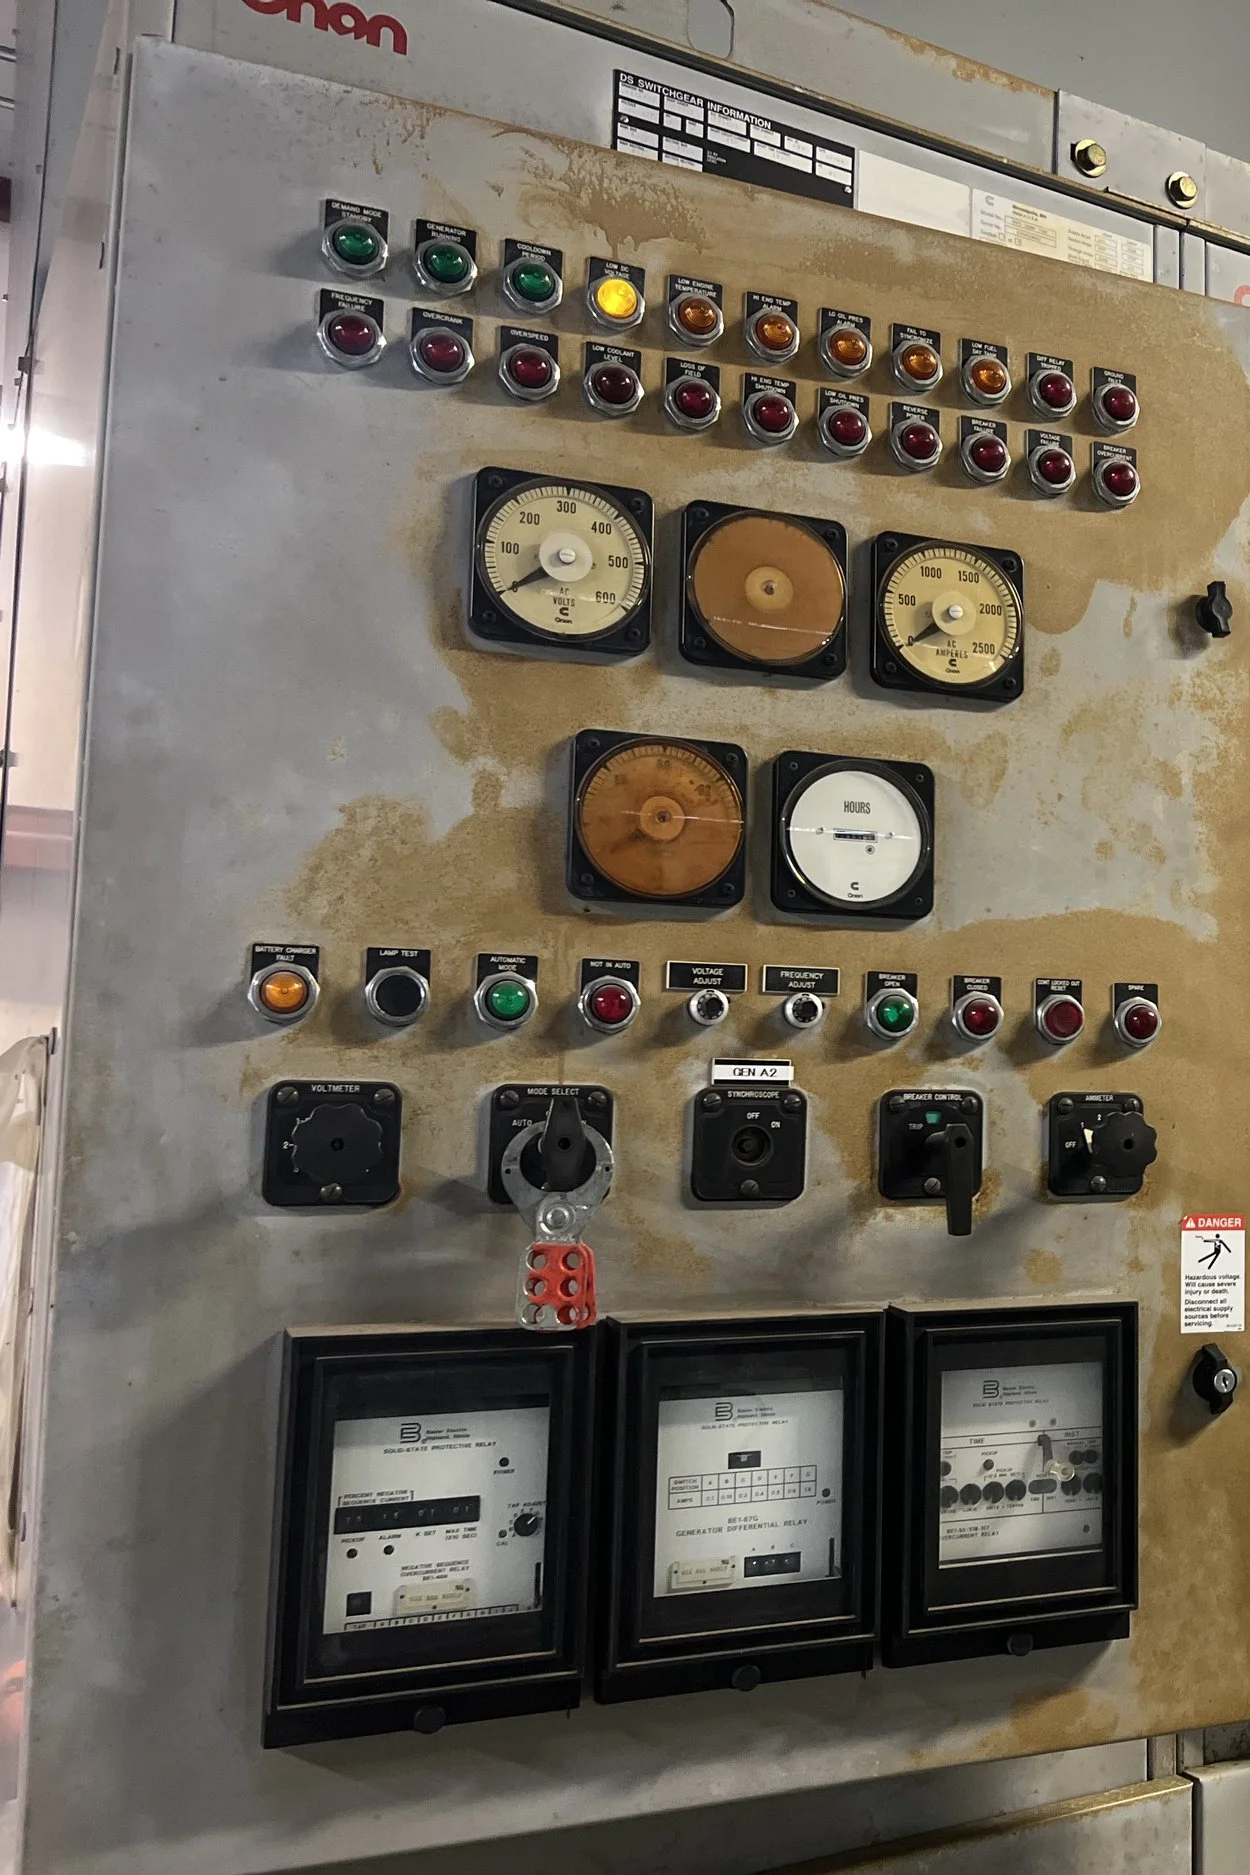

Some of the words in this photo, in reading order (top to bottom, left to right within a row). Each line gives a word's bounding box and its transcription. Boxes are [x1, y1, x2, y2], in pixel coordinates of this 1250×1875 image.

[620, 73, 633, 84] DS
[638, 79, 704, 107] SWITCHGEAR
[708, 102, 771, 129] INFORMATION
[332, 202, 360, 214] DEMAND
[363, 208, 382, 218] MODE
[427, 223, 466, 236] GENERATOR
[517, 244, 551, 256] COOLDOWN
[522, 252, 545, 262] PERIOD
[606, 262, 619, 270] LOW
[605, 268, 630, 280] VOLTAGE
[678, 278, 691, 286] LOW
[693, 280, 714, 290] ENGINE
[675, 284, 717, 298] TEMPERATURE
[331, 293, 372, 306] FREQUENCY
[423, 311, 463, 324] OVERCRANK
[511, 330, 549, 341] OVERSPEED
[593, 345, 605, 353] LOW
[607, 347, 635, 358] COOLANT
[604, 354, 622, 363] LEVEL
[680, 362, 696, 370] LOSS
[685, 370, 701, 378] FIELD
[557, 501, 577, 514] 300
[519, 512, 540, 525] 200
[591, 521, 612, 535] 400
[501, 542, 519, 554] 100
[608, 555, 628, 568] 500
[920, 566, 942, 579] 1000
[958, 570, 980, 584] 1500
[553, 597, 575, 607] VOLTS
[596, 592, 616, 604] 600
[898, 594, 916, 606] 500
[979, 603, 1002, 616] 2000
[947, 640, 956, 649] AC
[972, 642, 995, 655] 2500
[935, 648, 968, 659] AMPERES
[844, 800, 871, 814] HOURS
[255, 945, 284, 953] BATTERY
[286, 947, 317, 955] CHARGER
[490, 956, 526, 964] AUTOMATIC
[615, 962, 631, 970] AUTO
[692, 967, 724, 976] VOLTAGE
[780, 971, 824, 980] FREQUENCY
[964, 977, 990, 985] BREAKER
[693, 977, 722, 986] ADJUST
[788, 980, 816, 989] ADJUST
[733, 1068, 755, 1077] GEN
[760, 1068, 777, 1077] A2
[311, 1085, 360, 1093] VOLTMETER
[551, 1088, 580, 1096] SELECT
[728, 1090, 780, 1099] SYNCHROSCOPE
[903, 1093, 933, 1101] BREAKER
[934, 1094, 962, 1102] CONTROL
[747, 1112, 760, 1120] OFF
[512, 1119, 532, 1127] AUTO
[771, 1121, 781, 1129] ON
[1198, 1218, 1241, 1227] DANGER
[676, 1526, 723, 1537] GENERATOR
[727, 1522, 779, 1533] DIFFERENTIAL
